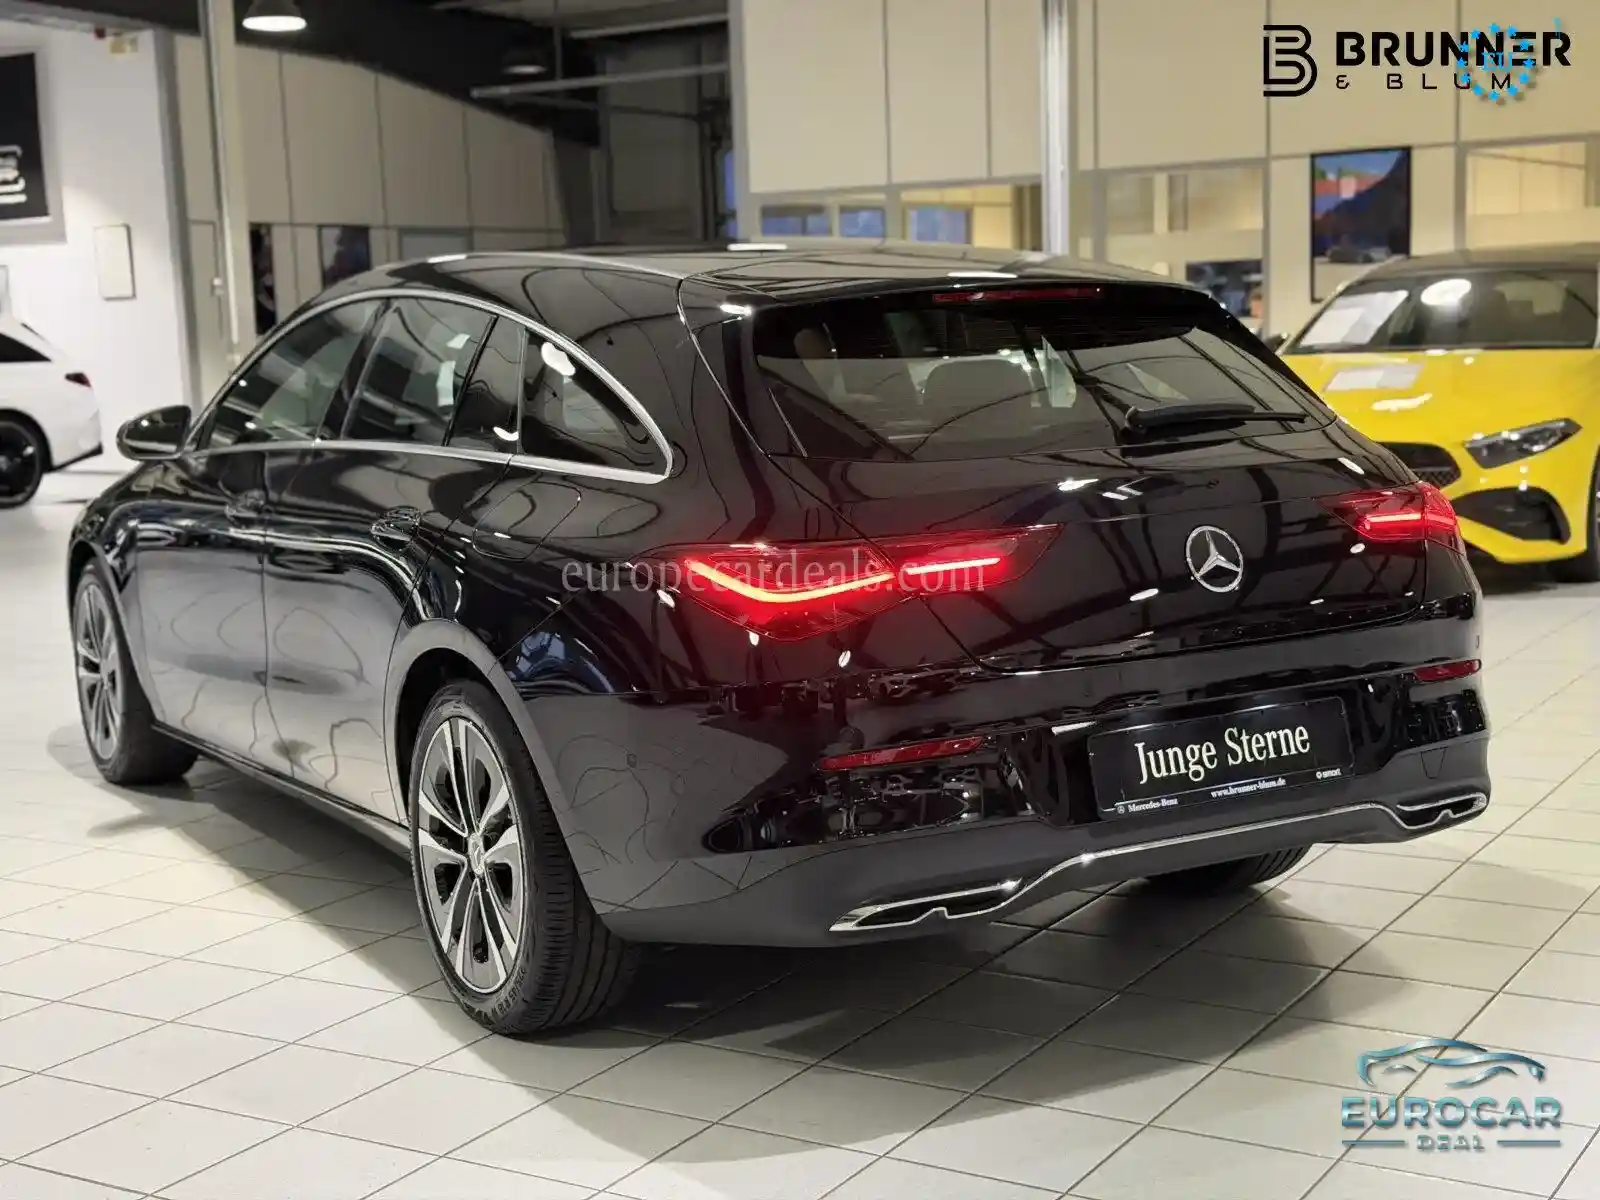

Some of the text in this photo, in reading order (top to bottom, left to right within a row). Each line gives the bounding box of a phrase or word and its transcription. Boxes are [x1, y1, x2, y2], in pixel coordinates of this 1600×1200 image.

[1134, 726, 1310, 784] Junge Sterne
[1128, 798, 1178, 812] Mercedes-Benz
